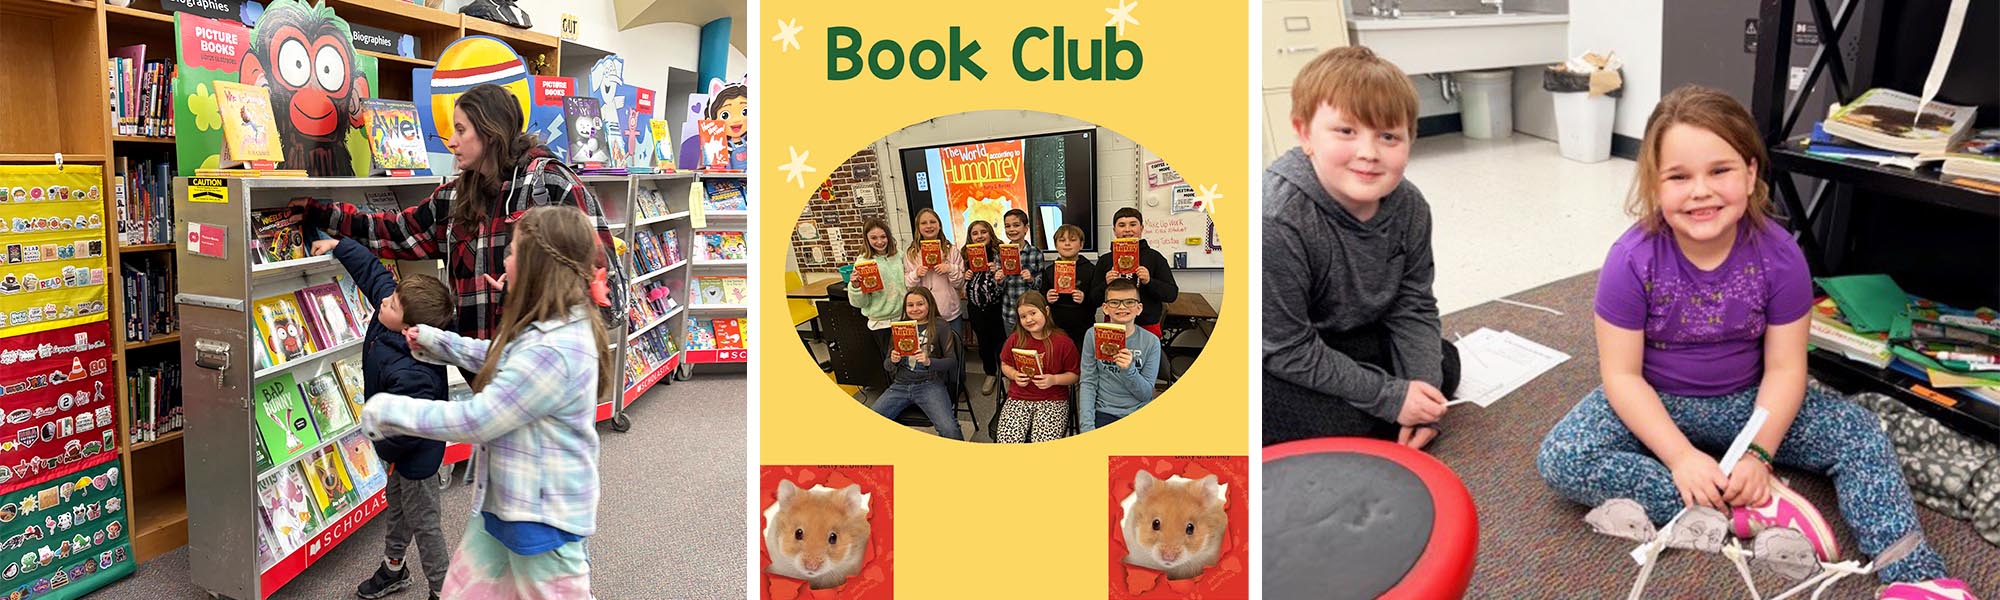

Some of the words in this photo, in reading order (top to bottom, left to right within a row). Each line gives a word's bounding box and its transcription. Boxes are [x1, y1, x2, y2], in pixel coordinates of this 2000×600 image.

[195, 26, 238, 45] PICTURE
[353, 30, 393, 48] Biographies
[200, 40, 235, 56] BOOKS
[542, 80, 567, 89] PICTURE
[544, 88, 565, 97] BOOKS
[943, 147, 960, 159] The
[959, 143, 987, 162] World
[942, 153, 1021, 187] Humphrey
[192, 178, 223, 187] CAUTION
[40, 277, 61, 289] READ
[641, 363, 670, 391] SCHOLASTIC
[262, 382, 285, 404] BAD
[262, 392, 293, 415] BUNNY
